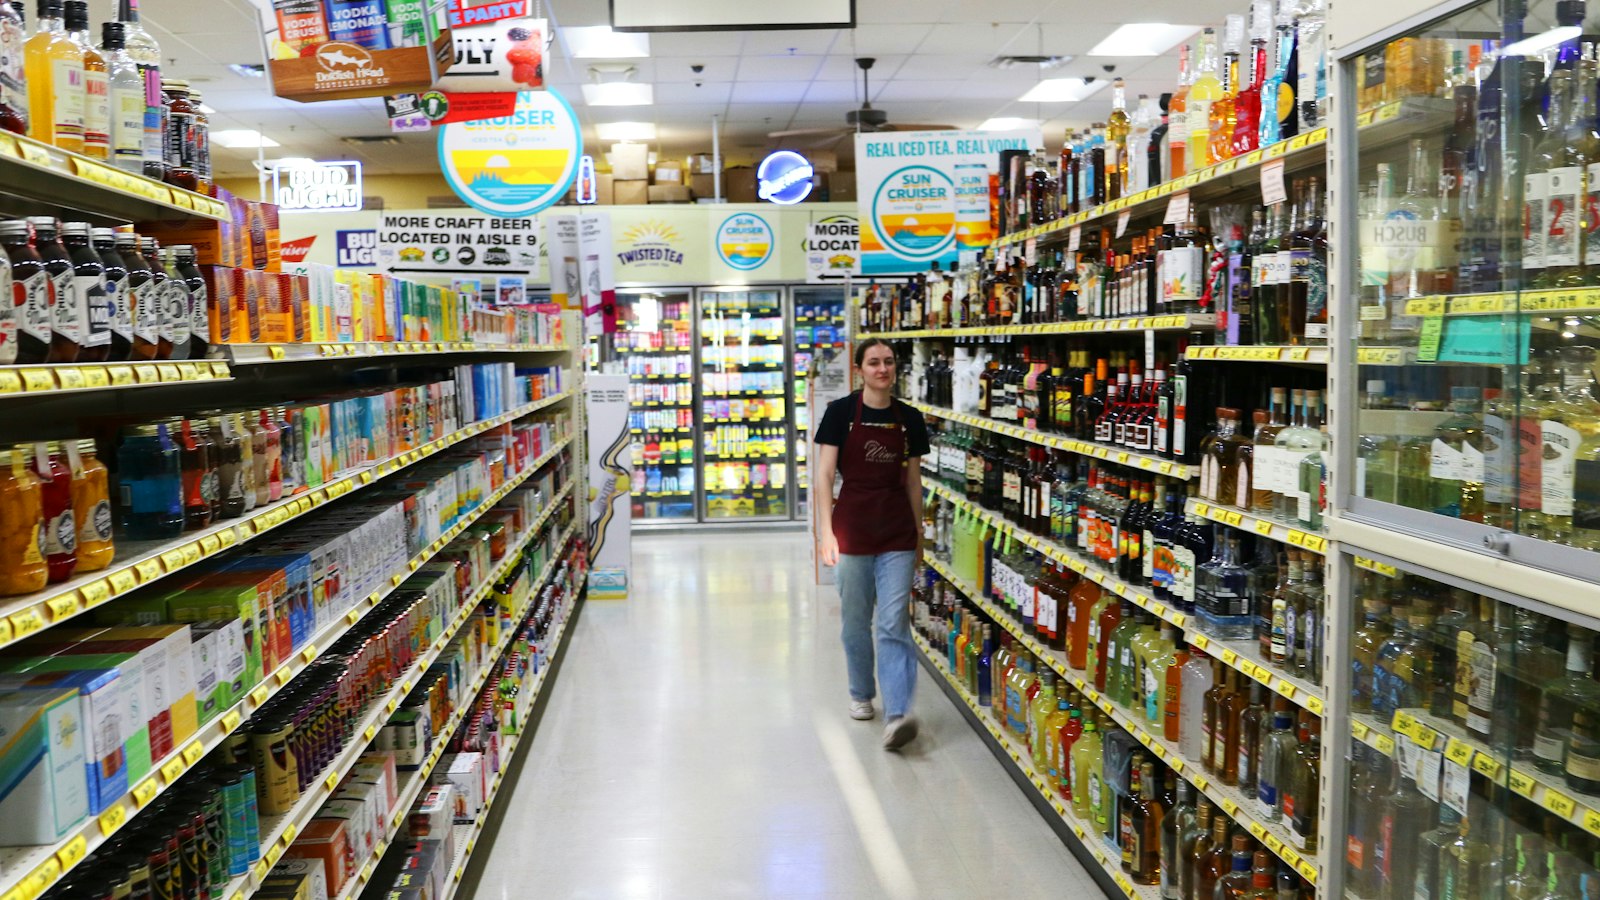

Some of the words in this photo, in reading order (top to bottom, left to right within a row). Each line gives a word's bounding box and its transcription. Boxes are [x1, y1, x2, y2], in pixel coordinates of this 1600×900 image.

[333, 5, 378, 20] VODKA
[465, 2, 525, 24] PARTY
[283, 17, 321, 29] VODKA
[329, 15, 387, 32] LEMONADE
[286, 26, 323, 39] CRUSH
[866, 142, 896, 157] REAL
[898, 141, 926, 156] ICED
[928, 140, 954, 155] TEA.
[956, 139, 985, 154] REAL
[289, 167, 349, 186] BUD
[902, 174, 932, 185] SUN
[280, 184, 358, 208] LIGHT
[887, 187, 947, 199] CRUISER
[385, 217, 429, 228] MORE
[434, 217, 485, 229] CRAFT
[490, 218, 531, 230] BEER
[1549, 198, 1564, 236] 2
[726, 227, 764, 235] CRUISER
[815, 224, 859, 236] MORE
[380, 232, 450, 244] LOCATED
[456, 234, 471, 244] IN
[477, 234, 521, 246] AISLE
[527, 235, 537, 246] 9
[617, 248, 663, 265] TWISTED
[664, 248, 684, 265] TEA
